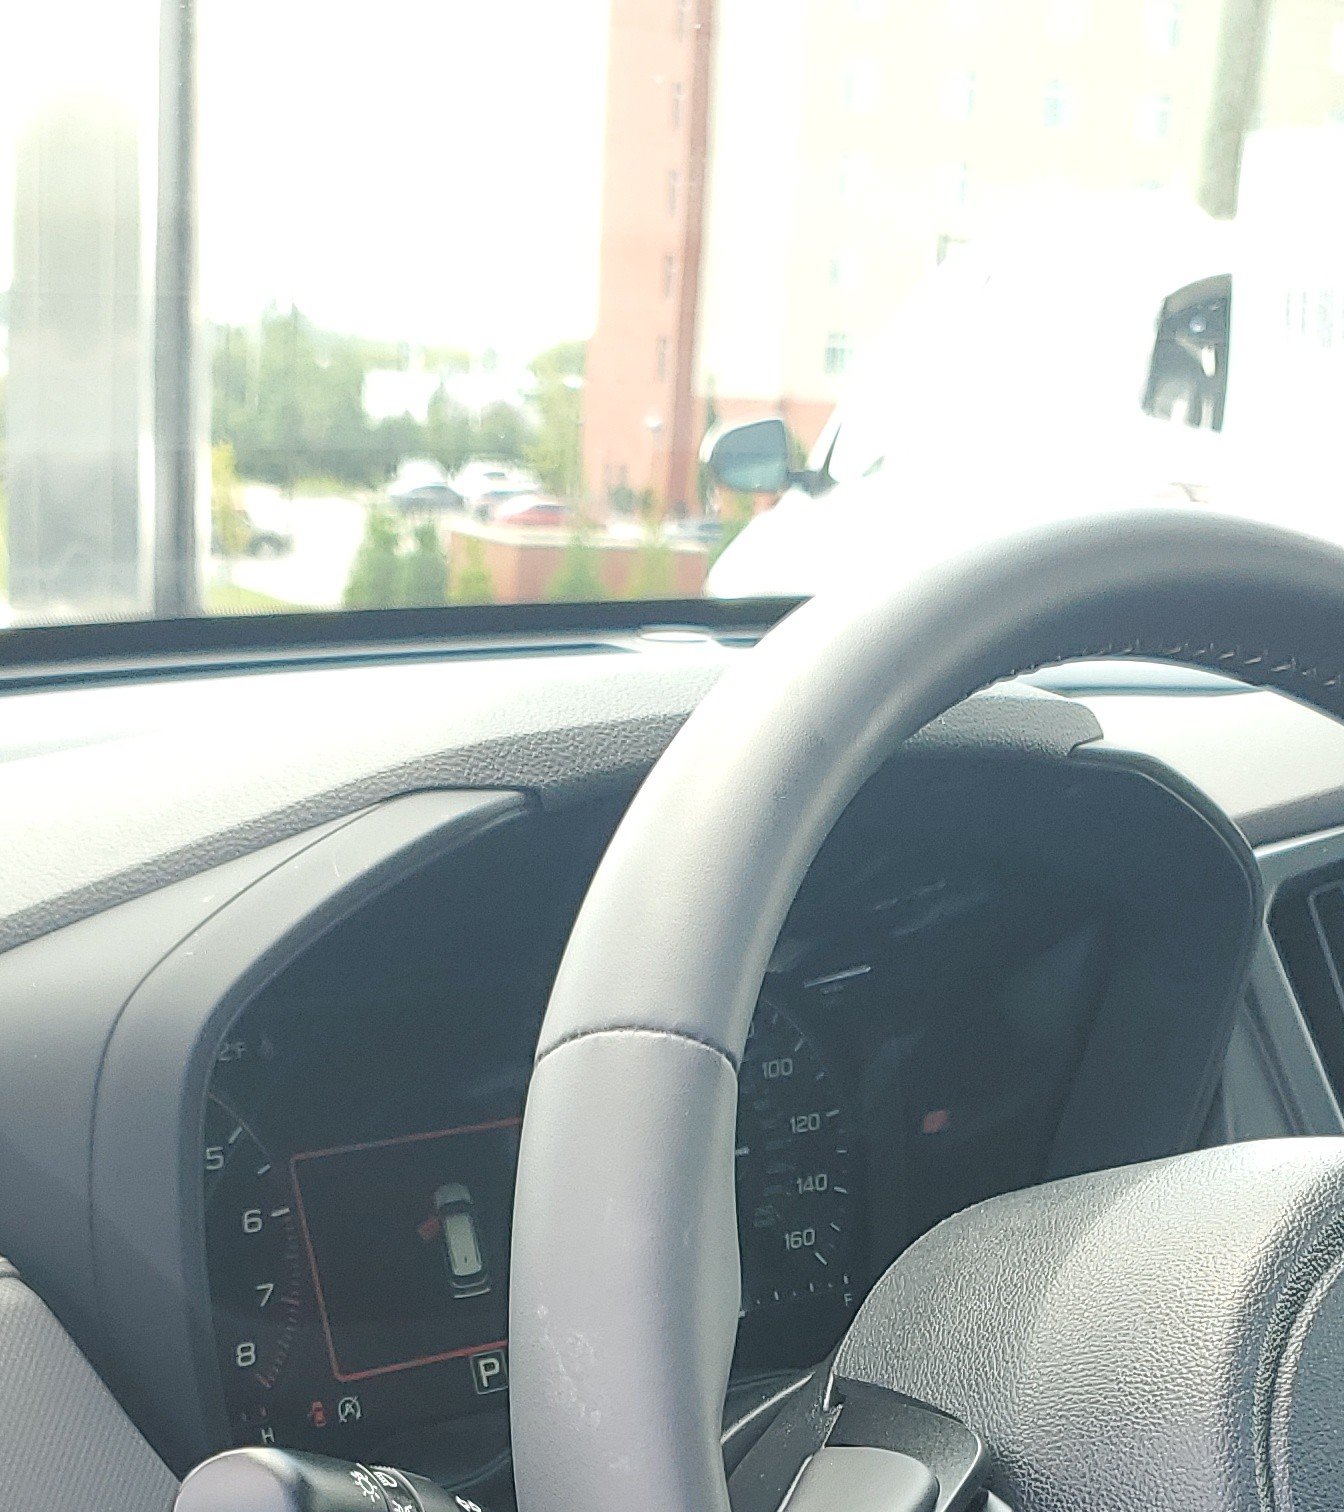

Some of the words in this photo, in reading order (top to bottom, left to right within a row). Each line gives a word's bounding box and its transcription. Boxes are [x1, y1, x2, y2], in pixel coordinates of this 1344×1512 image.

[762, 1058, 793, 1079] 100
[790, 1114, 821, 1133] 120
[205, 1147, 224, 1170] 5
[796, 1174, 828, 1194] 140
[243, 1209, 263, 1233] 6
[785, 1229, 816, 1250] 160
[256, 1284, 274, 1307] 7
[236, 1342, 256, 1367] 8
[478, 1358, 500, 1387] P
[261, 1427, 275, 1443] H
